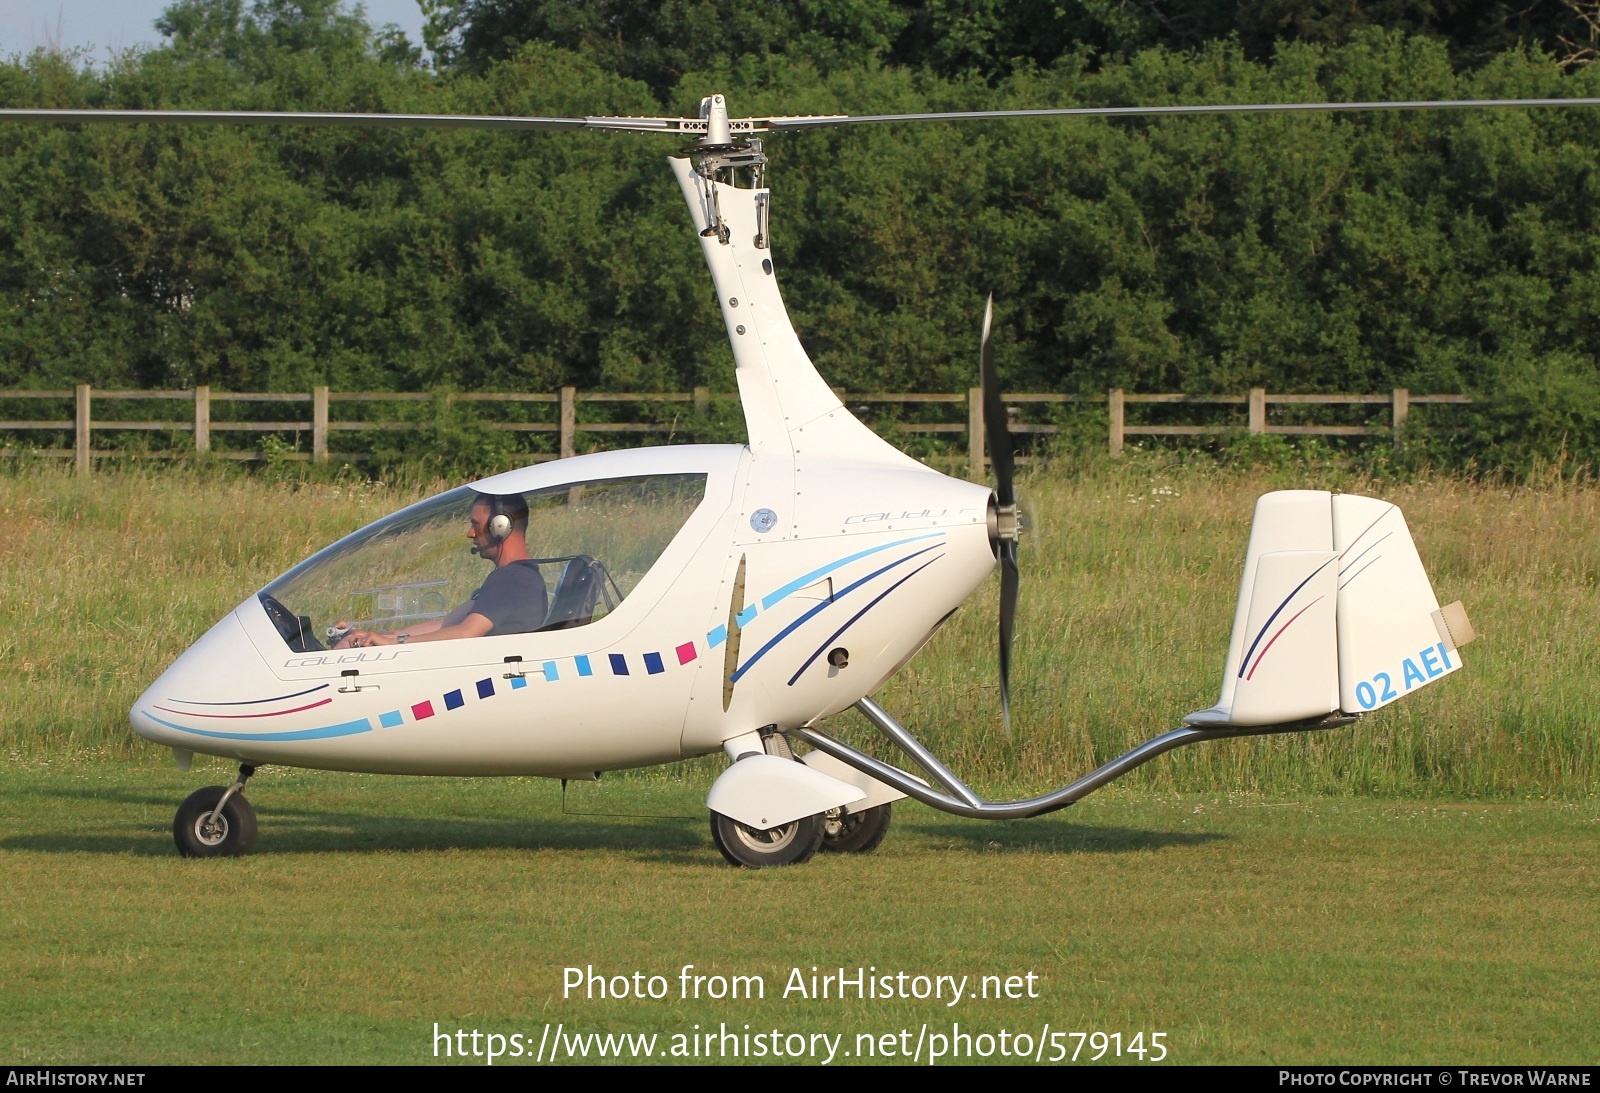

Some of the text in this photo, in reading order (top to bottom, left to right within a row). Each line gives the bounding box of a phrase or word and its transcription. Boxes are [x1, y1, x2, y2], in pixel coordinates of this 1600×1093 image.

[284, 650, 412, 667] calidus
[1355, 642, 1452, 709] 02 AEI
